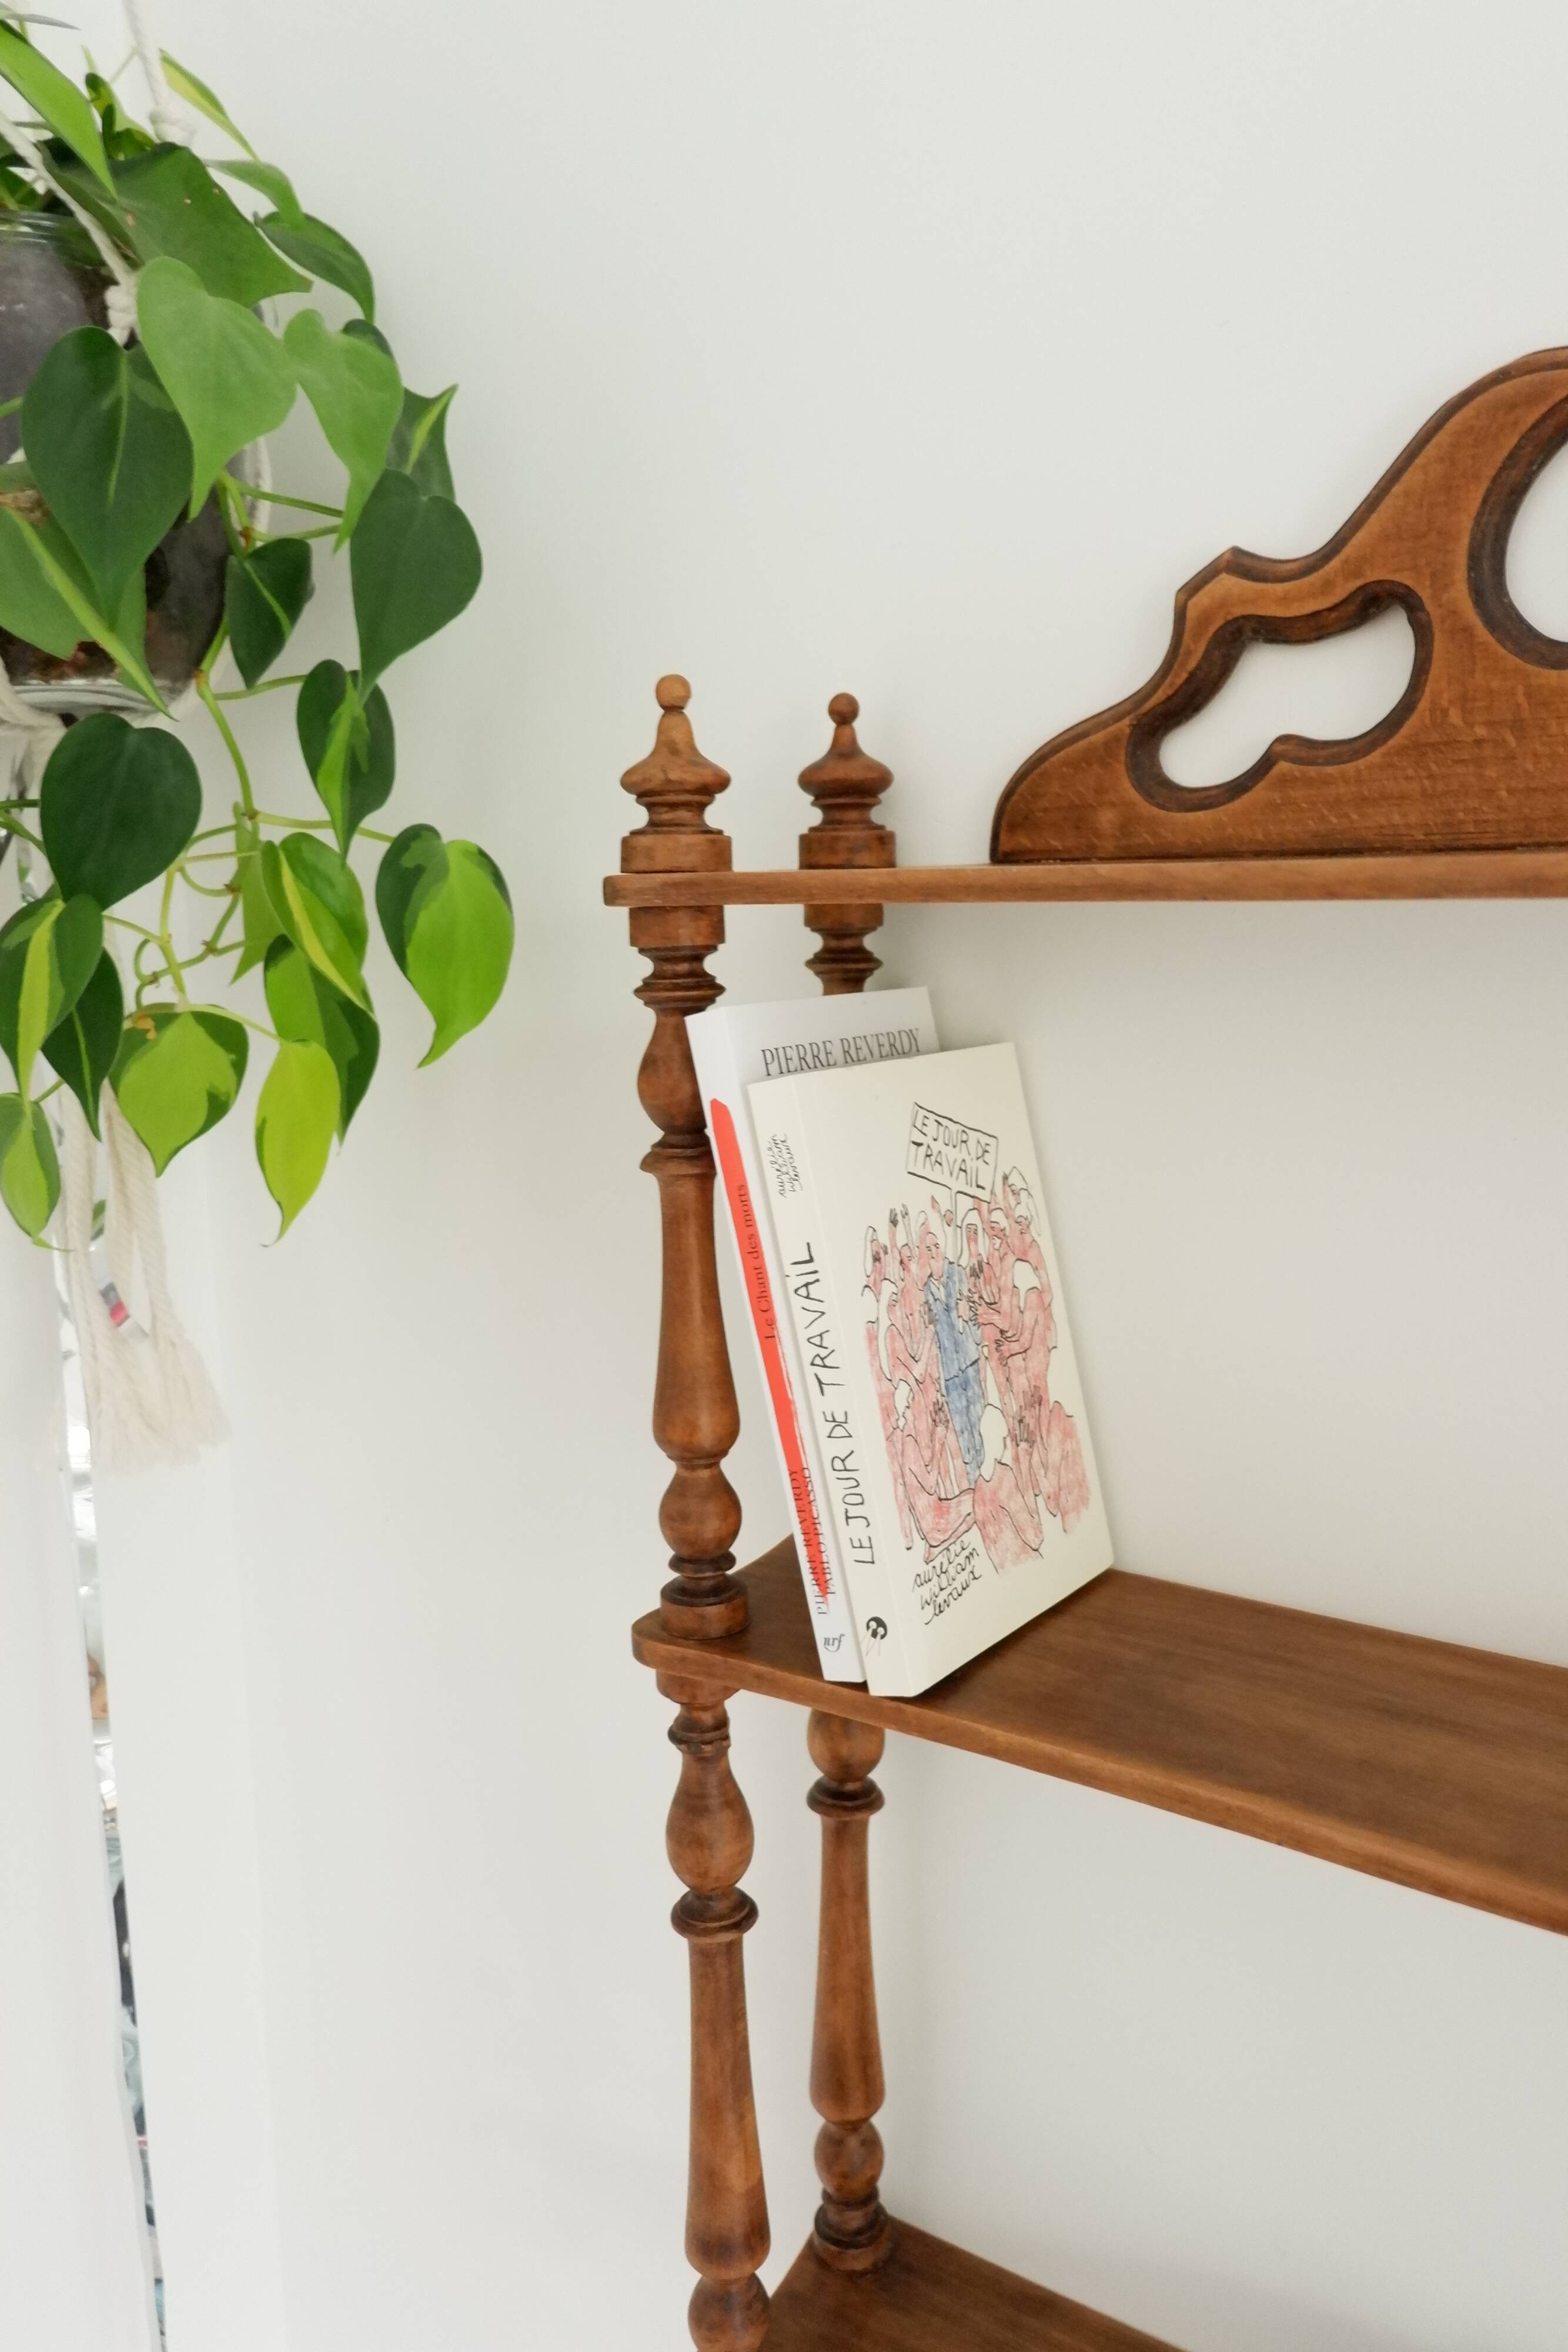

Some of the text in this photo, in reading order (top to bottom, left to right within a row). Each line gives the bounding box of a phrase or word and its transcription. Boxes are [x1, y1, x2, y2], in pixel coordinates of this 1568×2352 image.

[761, 1028, 920, 1077] PIERRE REVERDY
[913, 1109, 991, 1166] LE JOUR DE
[737, 1184, 776, 1339] Le Chant des morts
[823, 1410, 853, 1439] DE
[831, 1450, 870, 1528] JOUR
[789, 1471, 827, 1614] PIERRE REVERDY
[801, 1467, 836, 1594] PABLO PICASSO
[849, 1535, 875, 1565] LE
[823, 1633, 845, 1652] nrf
